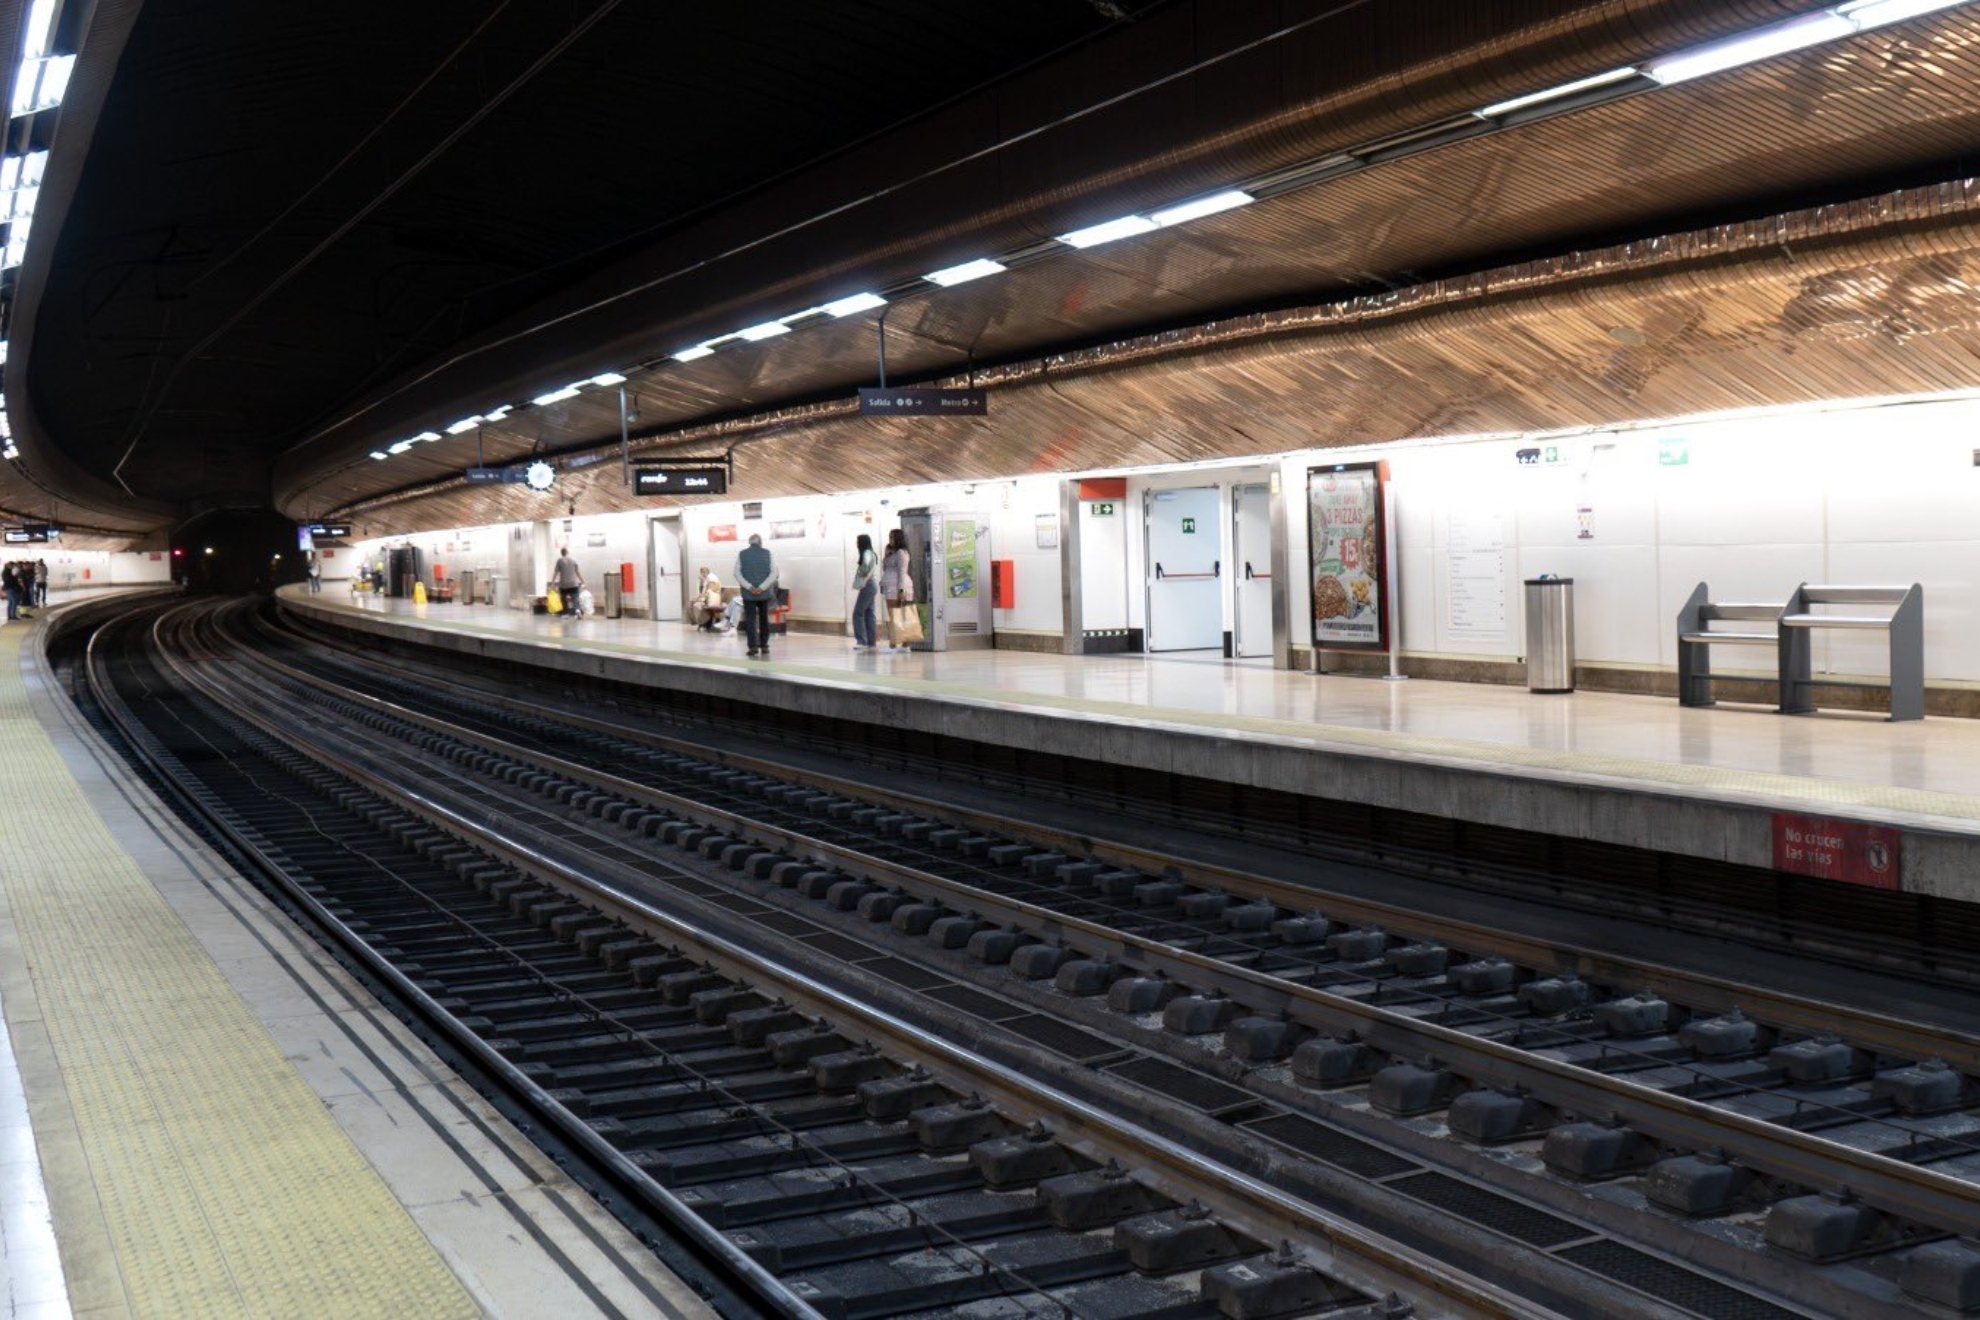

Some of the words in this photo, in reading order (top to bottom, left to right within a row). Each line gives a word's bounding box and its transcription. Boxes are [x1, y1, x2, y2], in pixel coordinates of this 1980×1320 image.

[869, 398, 891, 407] Salida
[941, 398, 962, 406] Metro
[1785, 827, 1801, 842] No
[1804, 833, 1844, 849] crucen
[1785, 844, 1803, 860] las
[1807, 848, 1832, 865] vías
